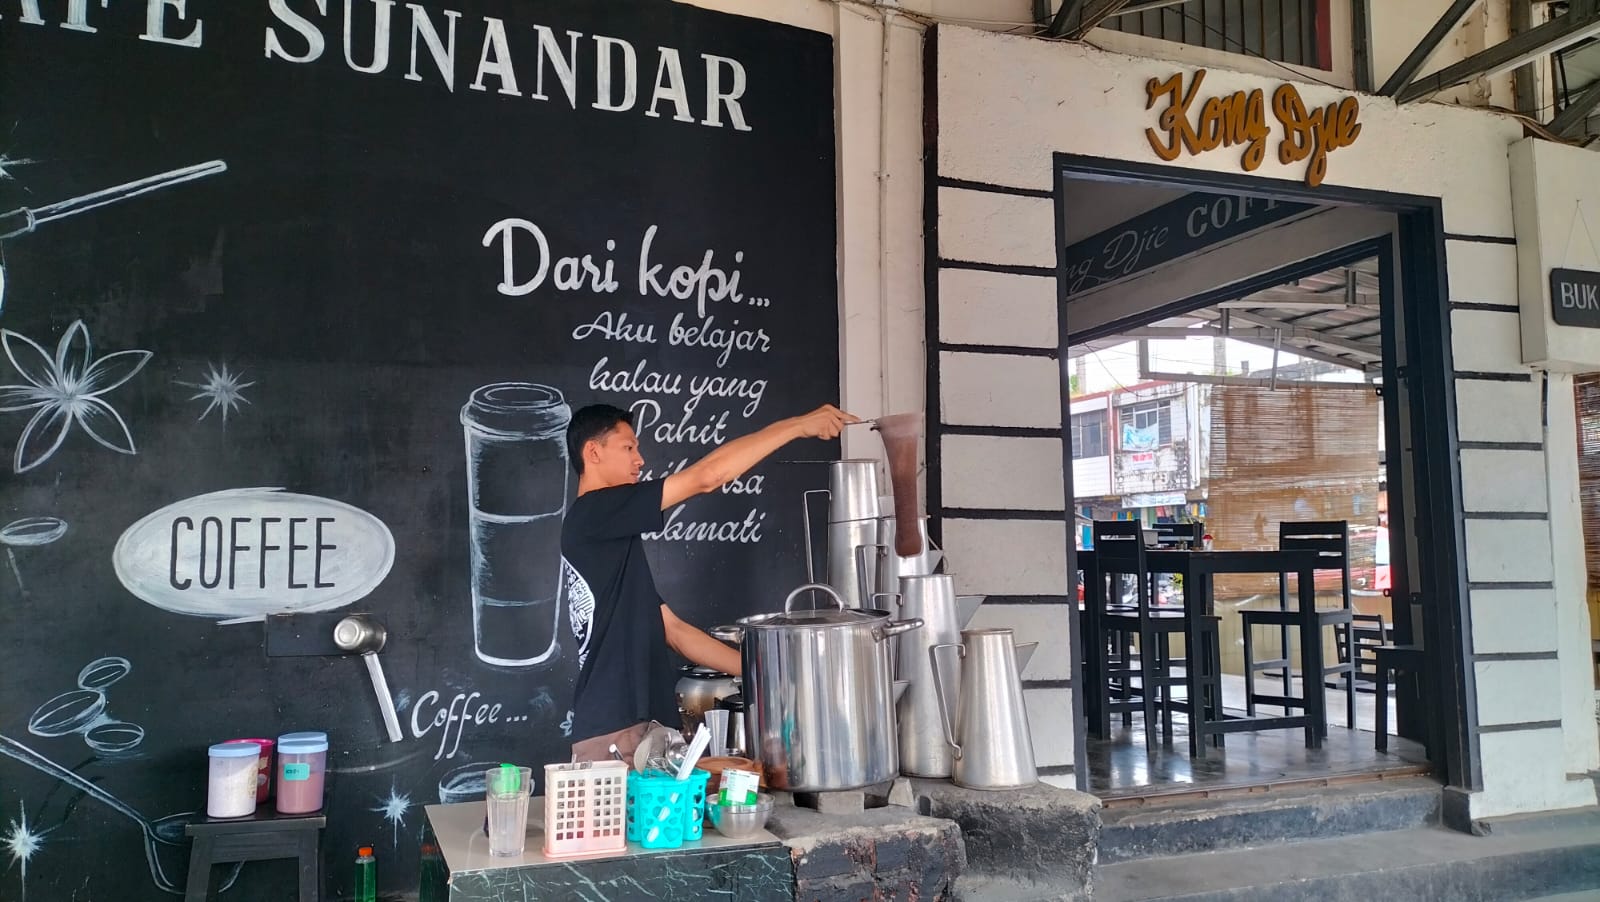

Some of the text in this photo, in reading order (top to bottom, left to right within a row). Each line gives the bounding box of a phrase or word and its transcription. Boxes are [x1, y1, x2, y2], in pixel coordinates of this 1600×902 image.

[264, 0, 753, 132] SUNANDAR
[1146, 69, 1271, 172] Kong
[482, 218, 619, 296] Dari
[572, 311, 771, 369] Aku belajar
[589, 356, 769, 420] kalau yang
[629, 399, 730, 445] Pahit
[168, 516, 338, 591] COFFEE
